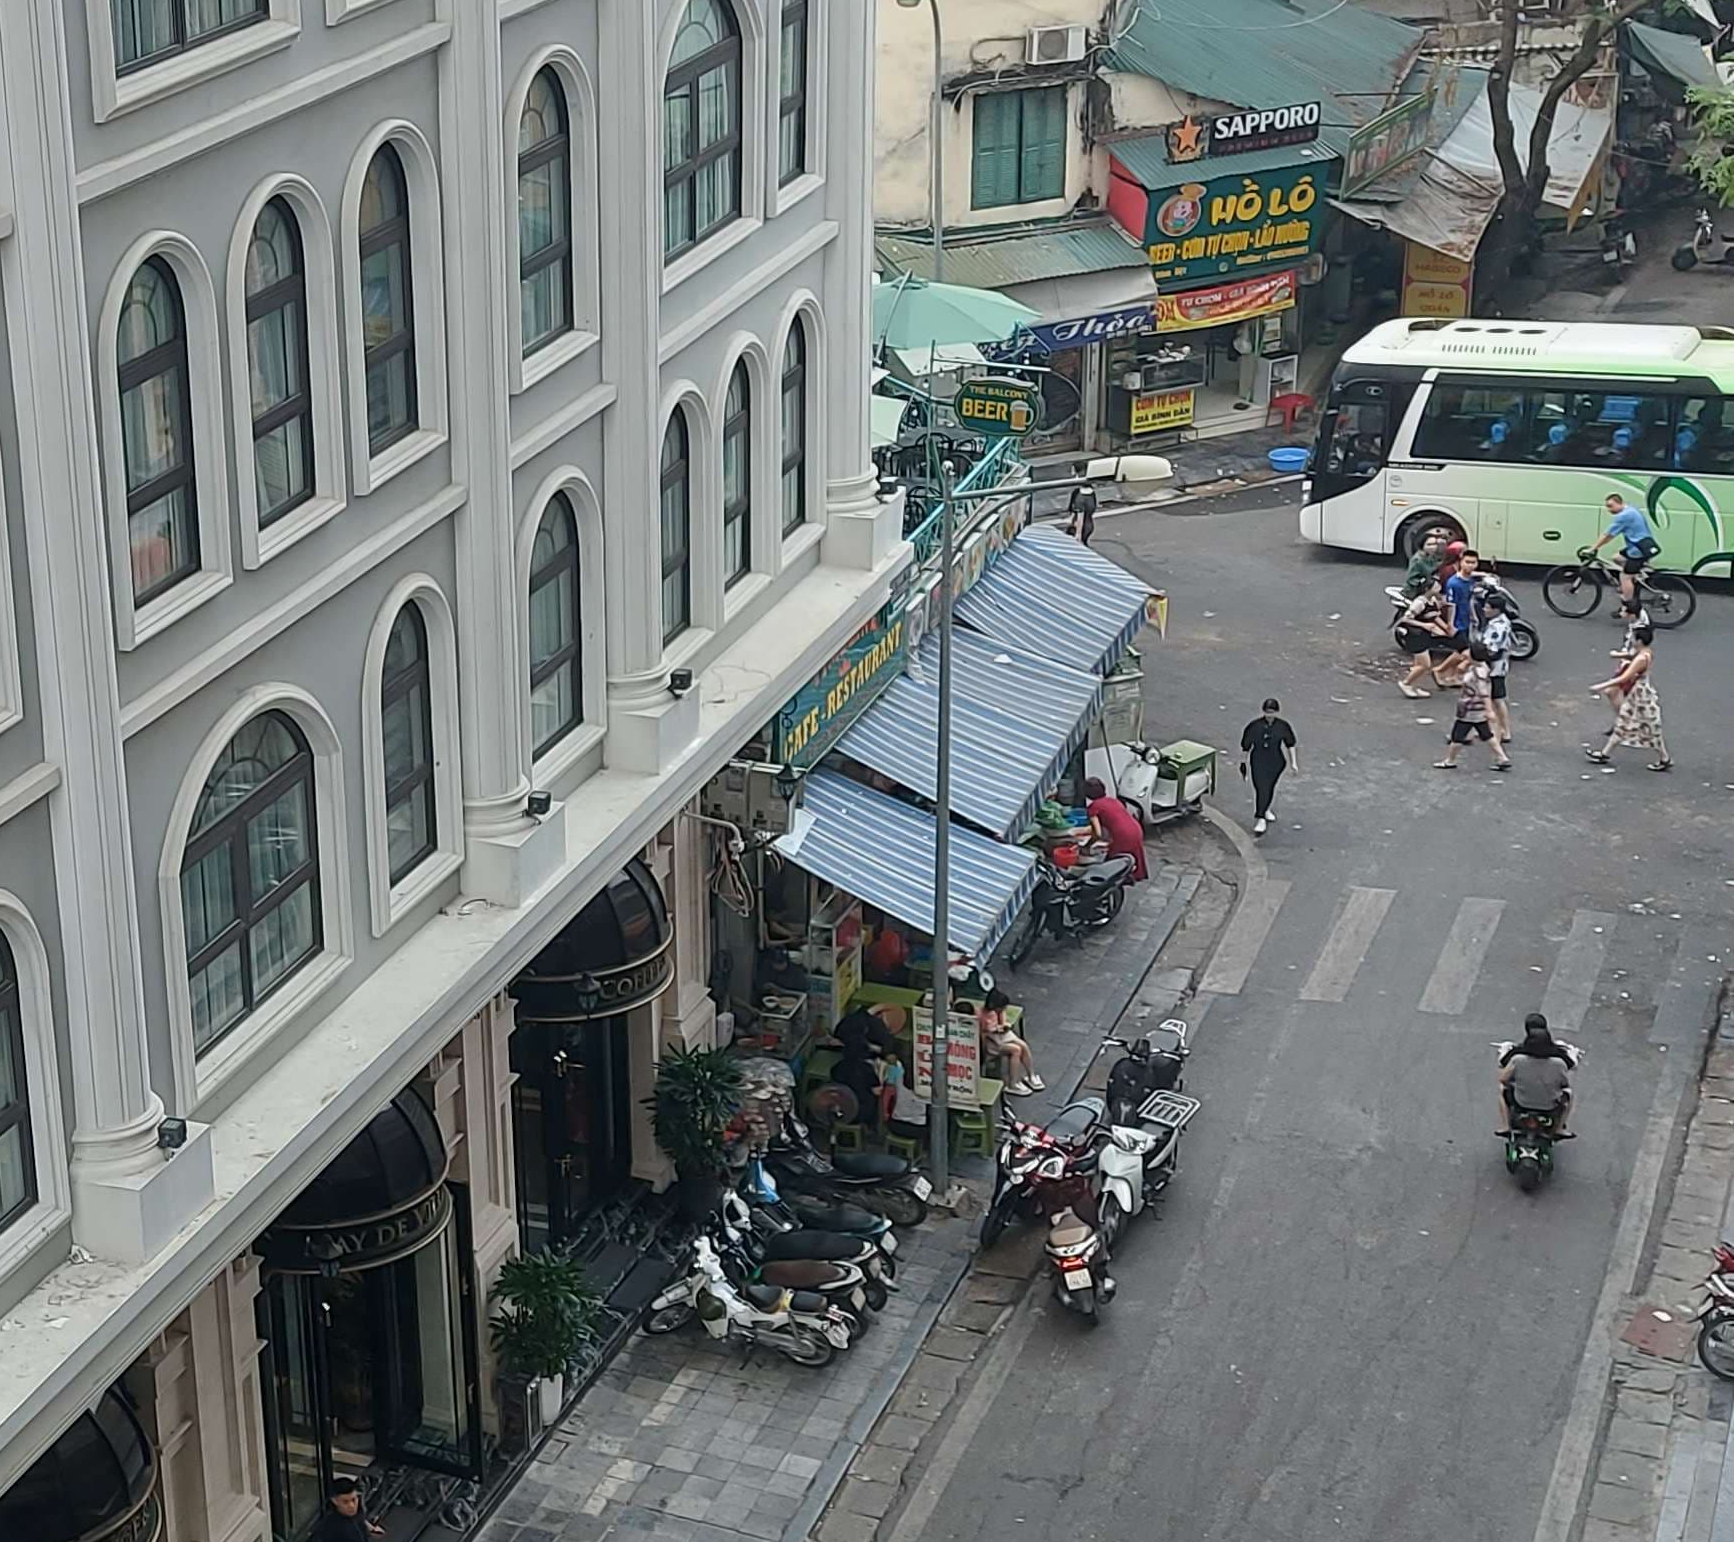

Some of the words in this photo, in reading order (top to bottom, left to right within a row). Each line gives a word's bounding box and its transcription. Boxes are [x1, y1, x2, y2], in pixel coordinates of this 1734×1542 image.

[1214, 103, 1319, 140] SAPPORO
[1211, 178, 1262, 226] HỒ
[1268, 175, 1316, 216] LÔ
[961, 398, 1008, 421] BEER
[987, 386, 1028, 400] BALCONY
[783, 707, 819, 763] CAFE
[824, 621, 902, 720] RESTAURANT
[377, 1217, 409, 1246] DE
